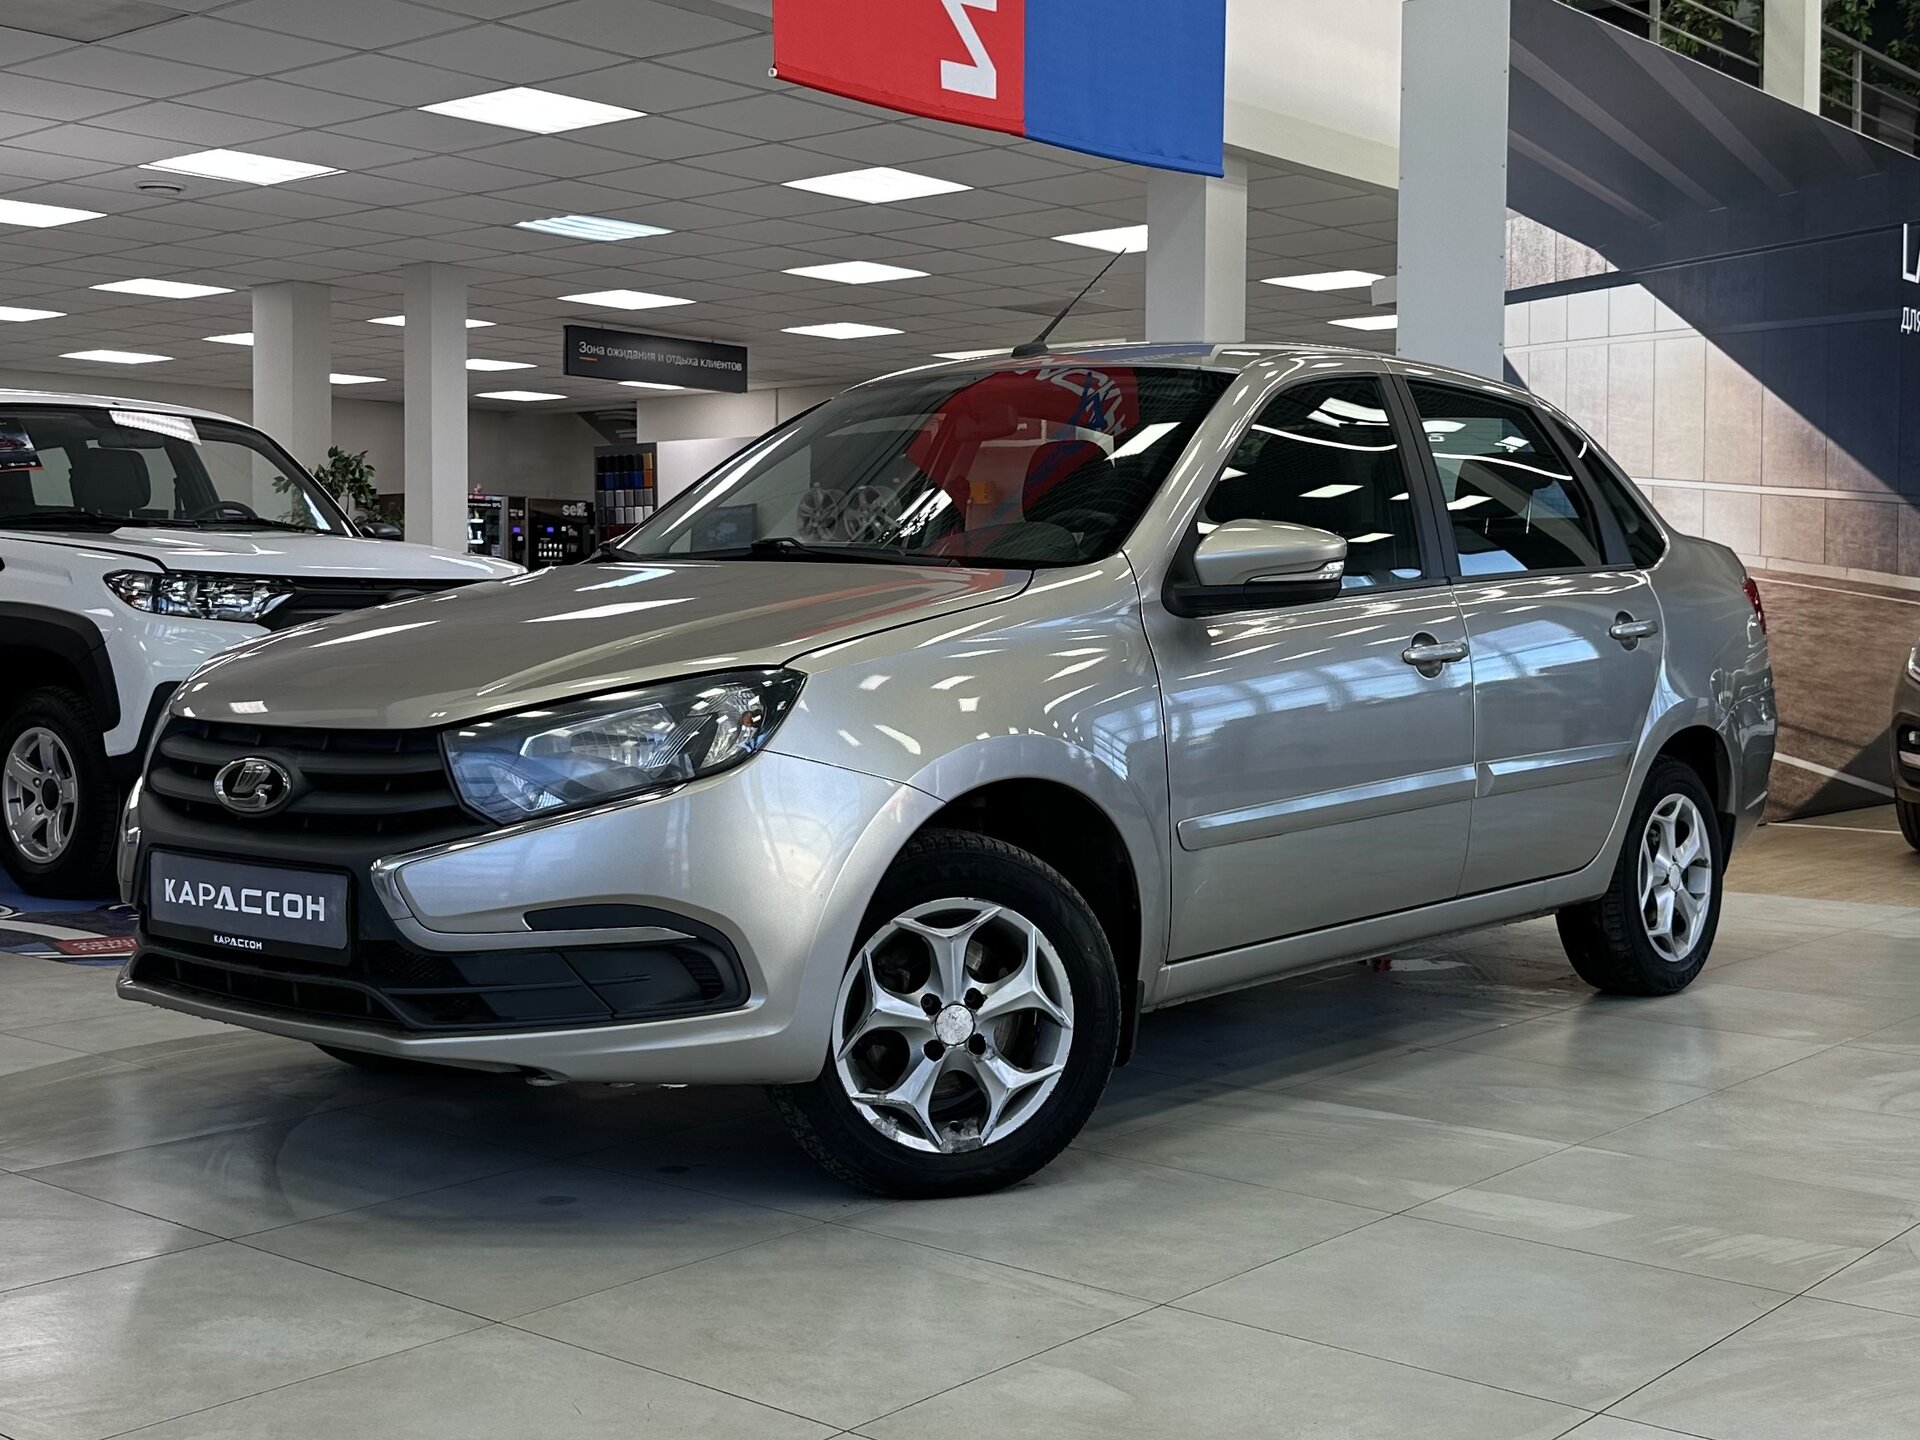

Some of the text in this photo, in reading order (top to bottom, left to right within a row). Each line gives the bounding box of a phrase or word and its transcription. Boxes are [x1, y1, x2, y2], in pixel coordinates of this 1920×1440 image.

[1902, 223, 1920, 284] L
[578, 341, 742, 371] Зона ожидания и отдыха клиентов
